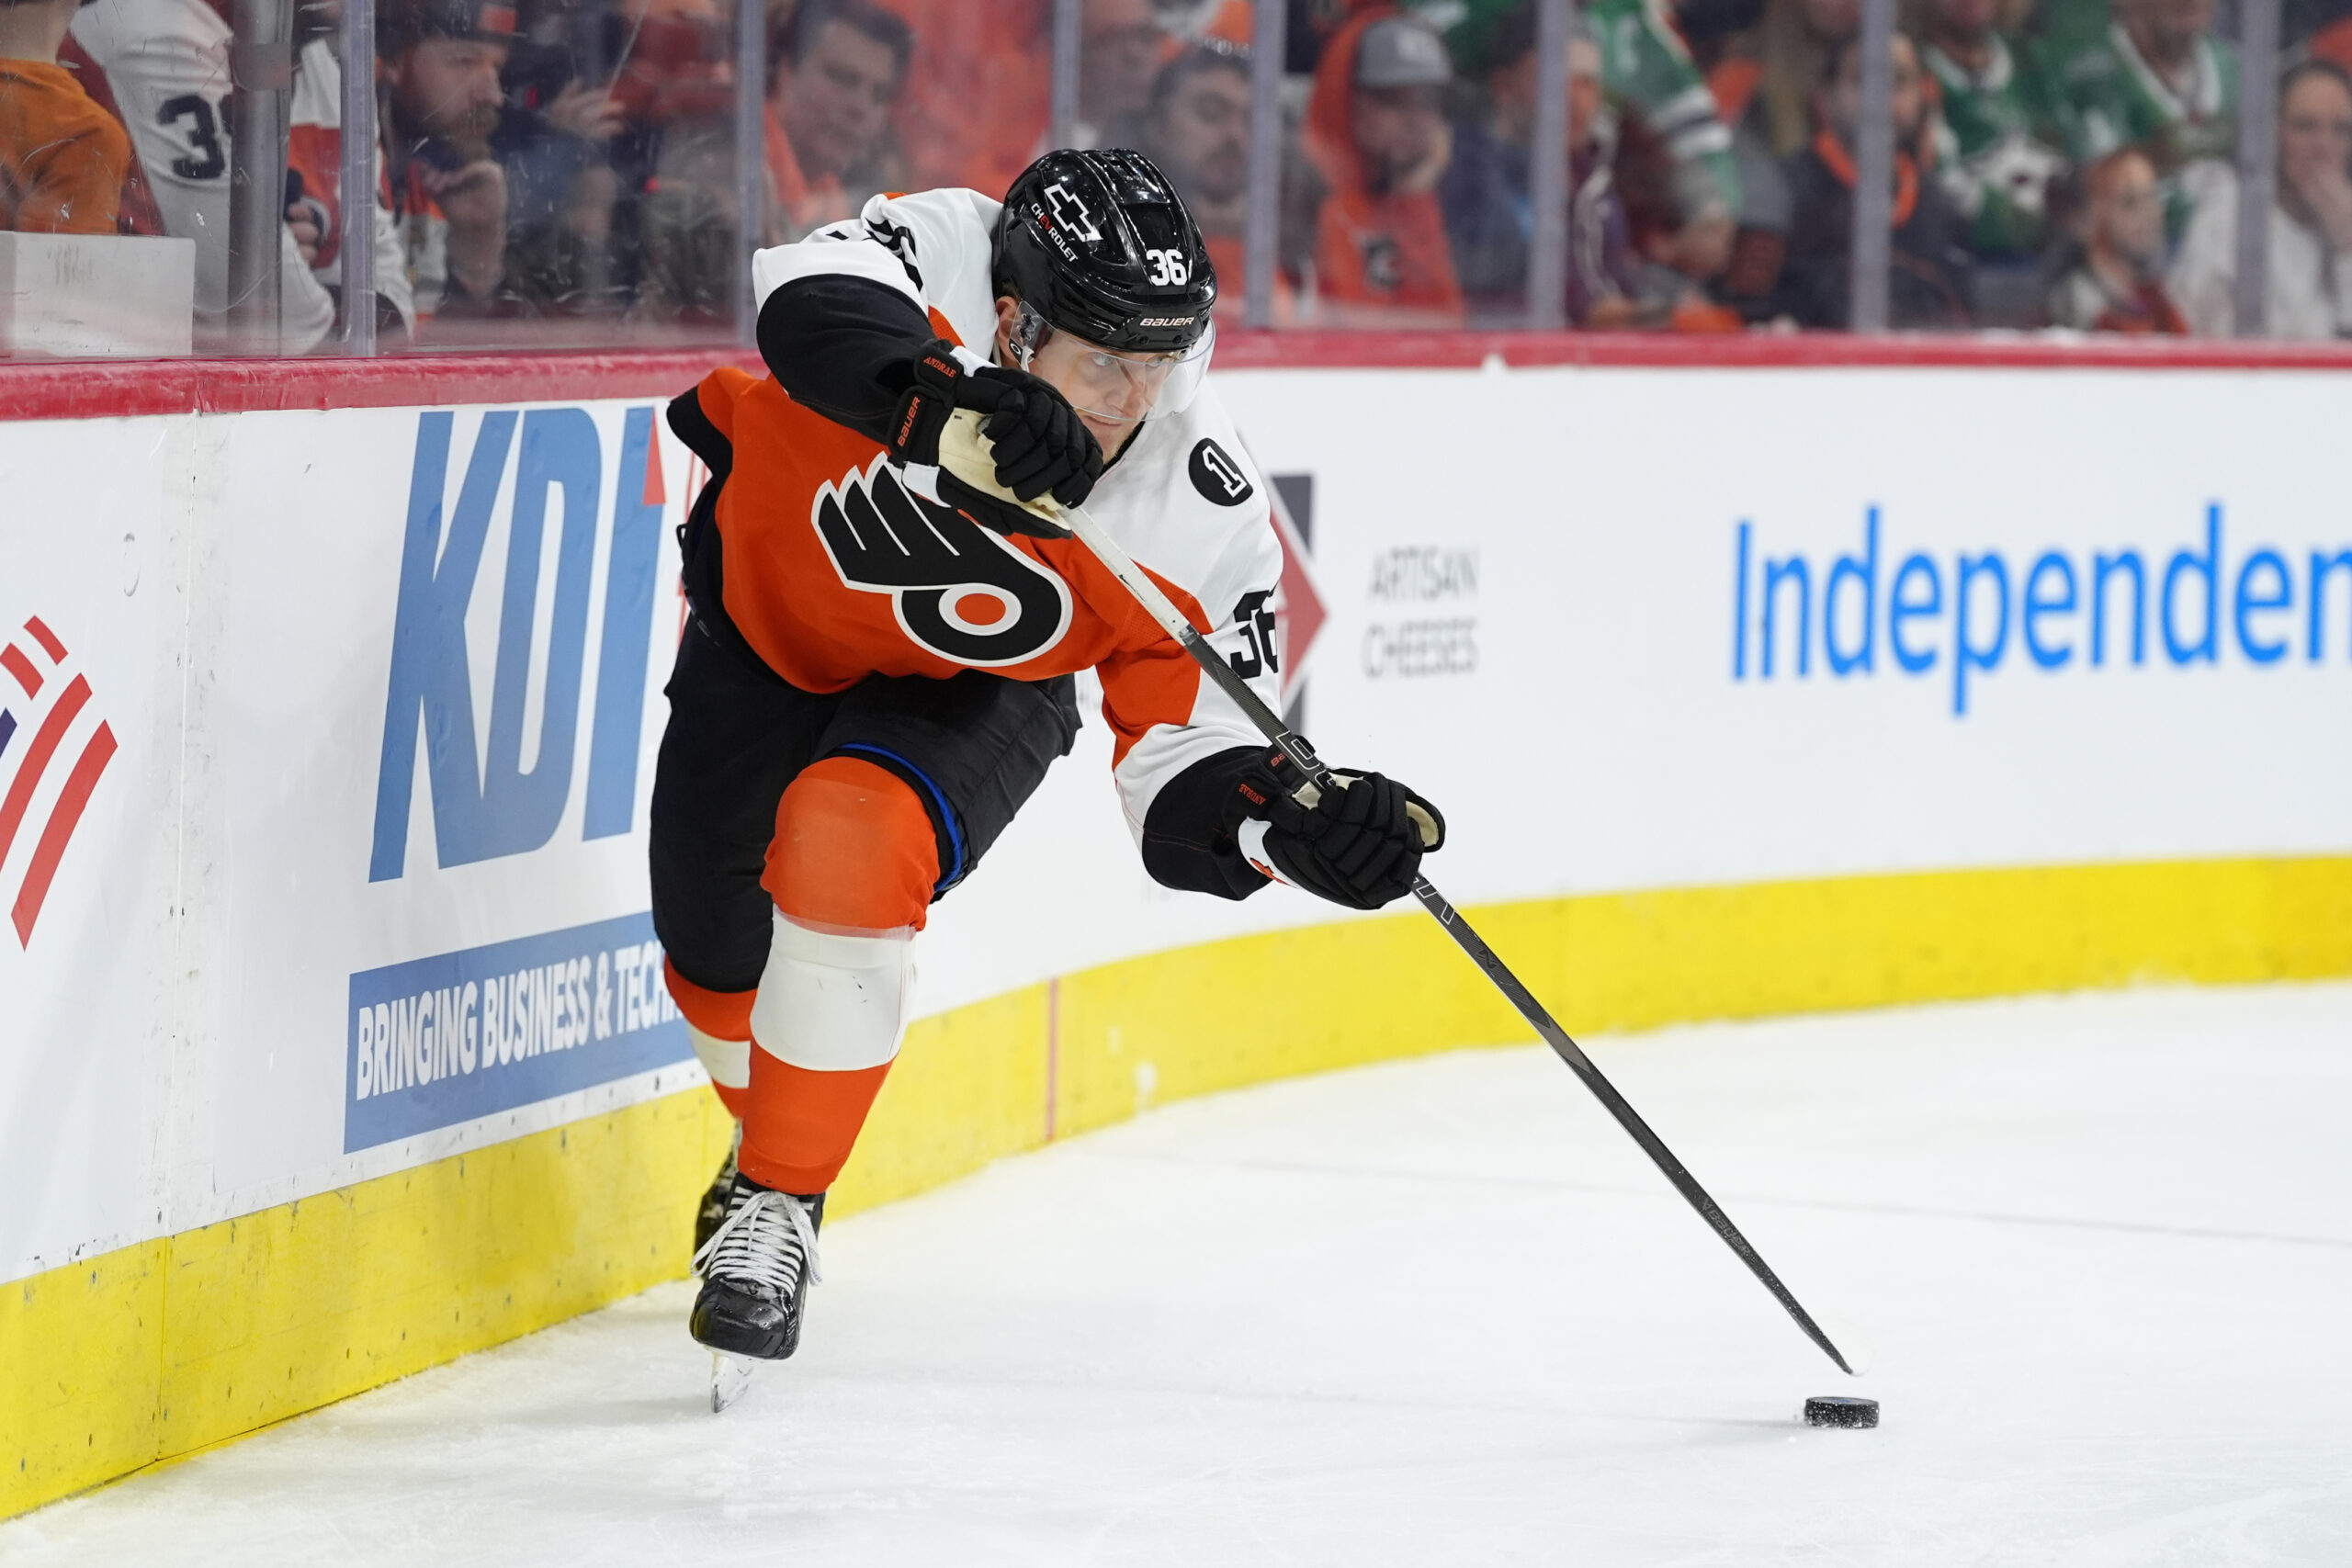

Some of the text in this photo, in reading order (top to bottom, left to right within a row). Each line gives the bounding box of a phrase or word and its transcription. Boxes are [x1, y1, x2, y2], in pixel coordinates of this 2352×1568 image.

[156, 95, 228, 179] 3
[1030, 202, 1079, 263] CHEVROLET
[1146, 249, 1188, 287] 36
[923, 356, 956, 378] ANDRAE
[1202, 445, 1248, 499] 1
[1366, 545, 1480, 601] ARTISAN
[368, 406, 667, 884] KDI
[1360, 617, 1479, 681] CHEESES
[356, 939, 685, 1101] BRINGING BUSINESS & TECH
